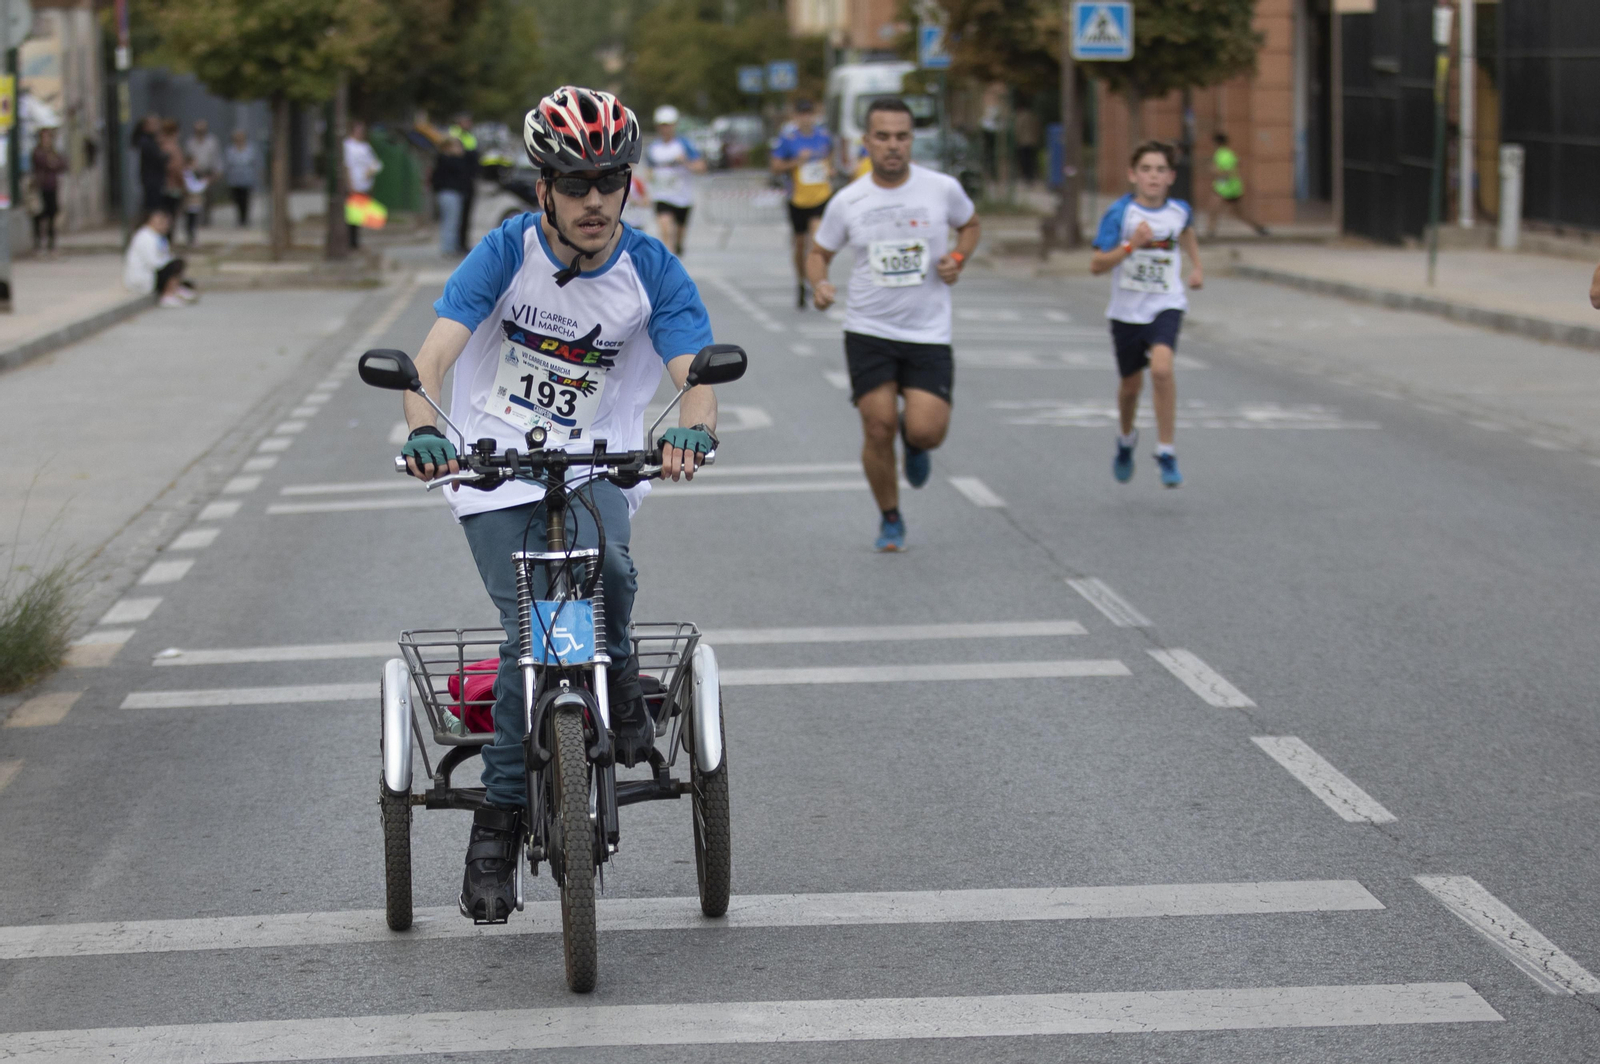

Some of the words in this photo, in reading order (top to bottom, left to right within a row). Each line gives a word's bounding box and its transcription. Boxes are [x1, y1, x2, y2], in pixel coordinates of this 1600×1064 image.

[881, 253, 921, 270] 1080
[511, 304, 537, 327] VII
[540, 310, 578, 328] CARRERA
[538, 320, 576, 338] MARCHA
[511, 332, 601, 364] ASPACE
[529, 354, 549, 368] CARRERA
[549, 363, 571, 376] MARCHA
[551, 375, 589, 388] ASPACE
[520, 373, 577, 417] 193
